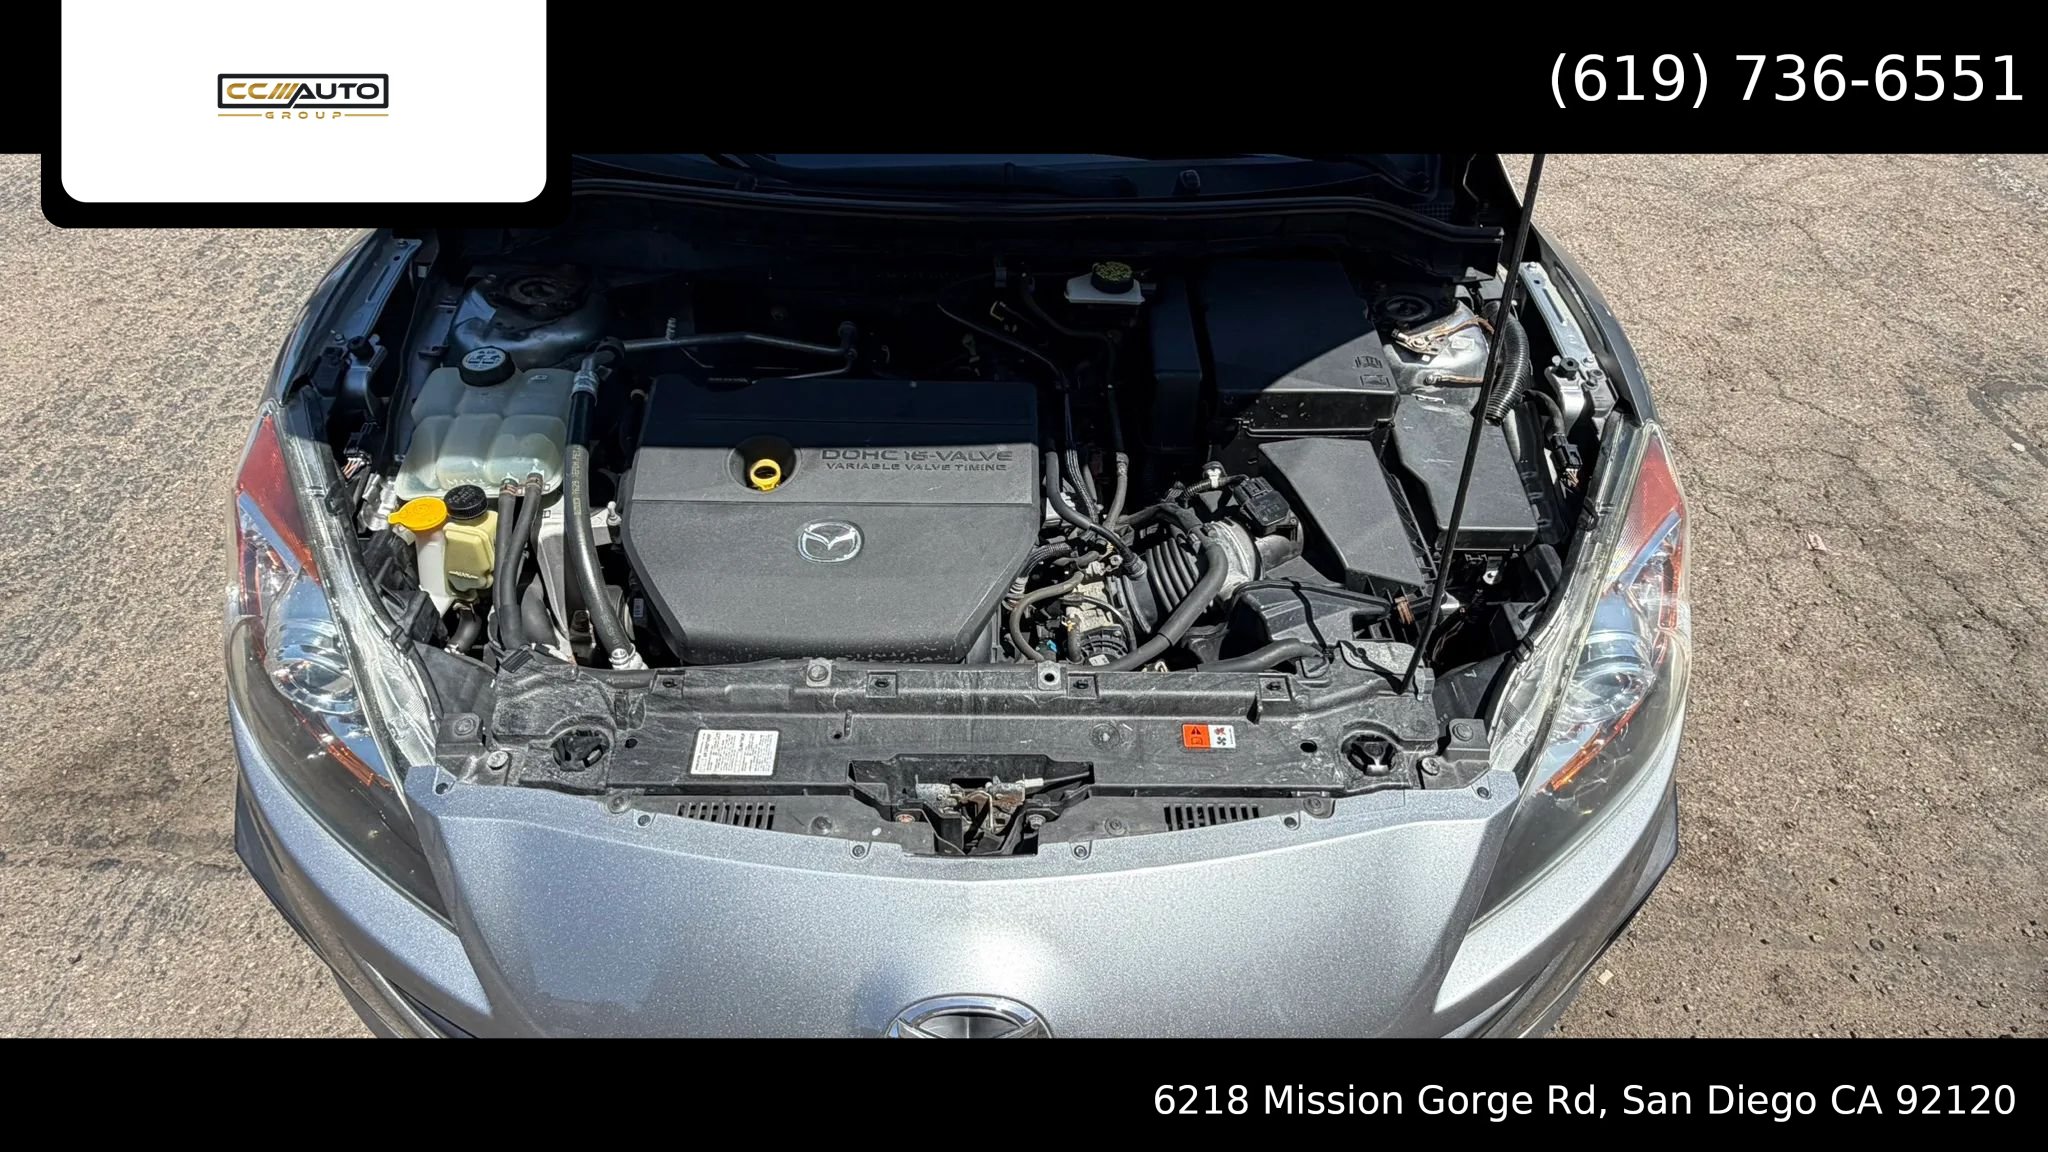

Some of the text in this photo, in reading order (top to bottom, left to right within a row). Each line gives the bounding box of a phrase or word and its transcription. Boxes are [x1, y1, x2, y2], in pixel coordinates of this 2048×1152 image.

[821, 449, 1014, 462] DOHC 16-VALVE
[826, 462, 1007, 472] VARIABLE VALVE TIMING
